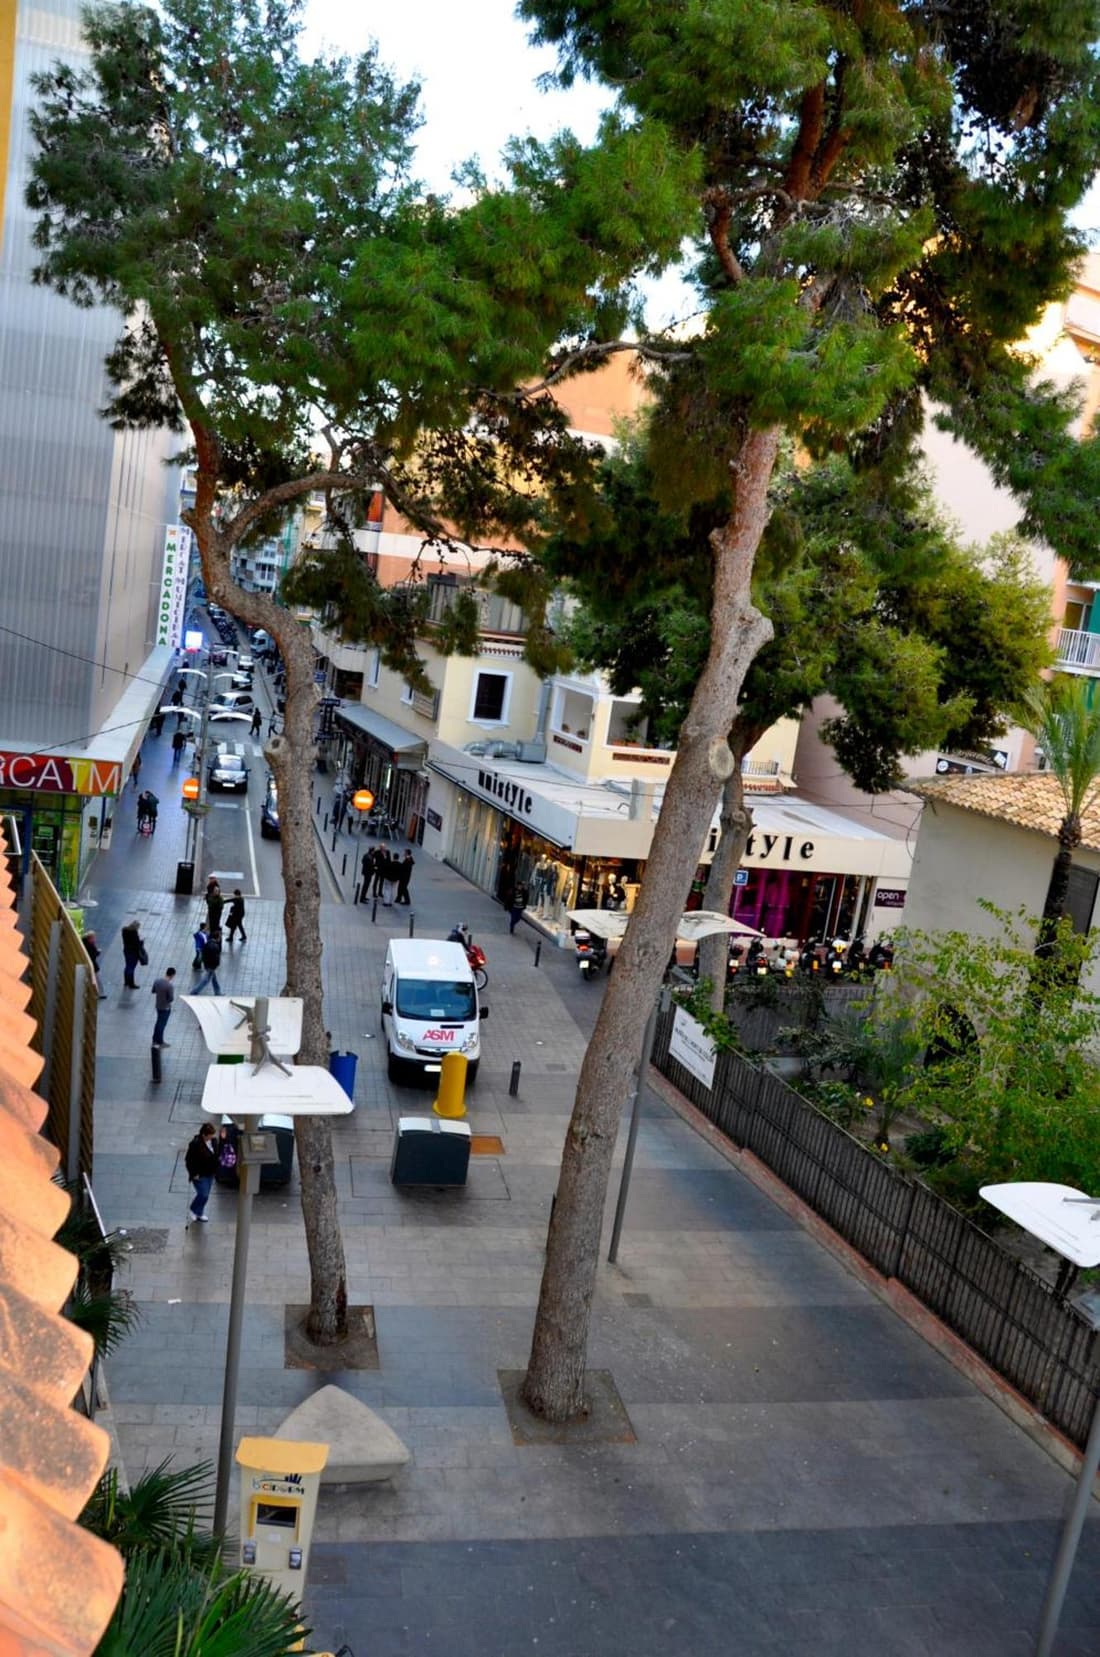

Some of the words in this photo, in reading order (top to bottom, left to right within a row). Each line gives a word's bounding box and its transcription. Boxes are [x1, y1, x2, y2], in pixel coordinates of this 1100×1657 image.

[158, 543, 176, 645] MERCADONA
[478, 769, 532, 813] unistyle
[877, 891, 900, 901] open
[423, 1029, 454, 1040] ASM
